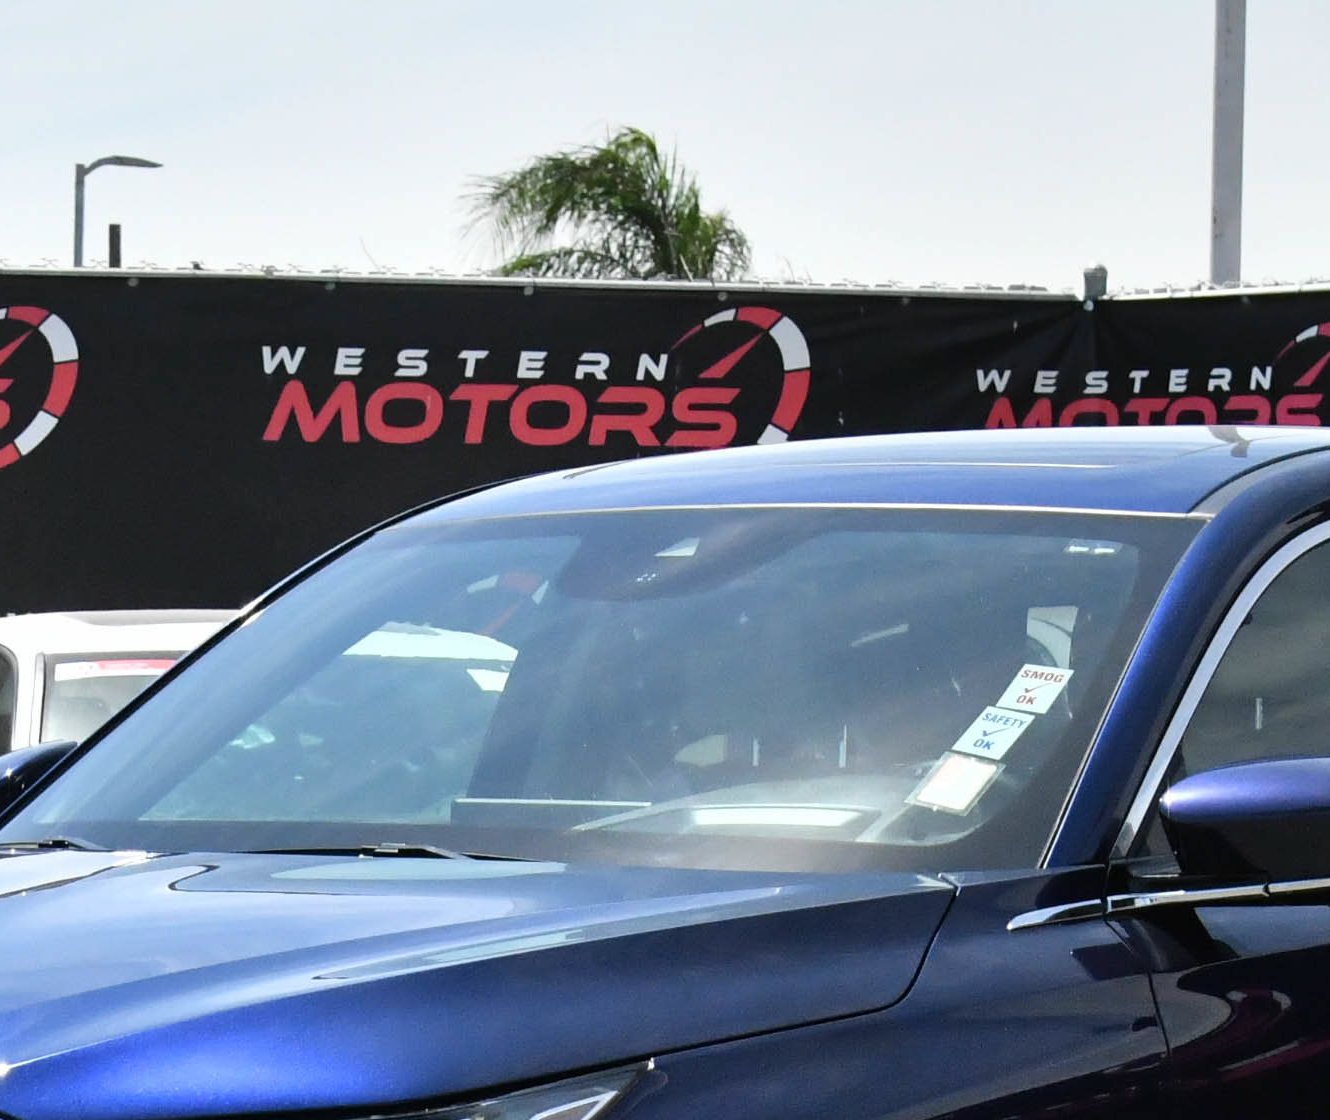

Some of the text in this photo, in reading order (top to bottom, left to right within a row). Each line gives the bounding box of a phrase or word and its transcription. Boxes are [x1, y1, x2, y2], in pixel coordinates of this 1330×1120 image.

[261, 345, 670, 382] WESTERN
[976, 365, 1274, 394] WESTERN
[261, 380, 742, 448] MOTORS
[1022, 670, 1064, 683] SMOG
[1016, 695, 1036, 704] OK
[983, 713, 1026, 728] SAFETY
[973, 739, 994, 750] OK
